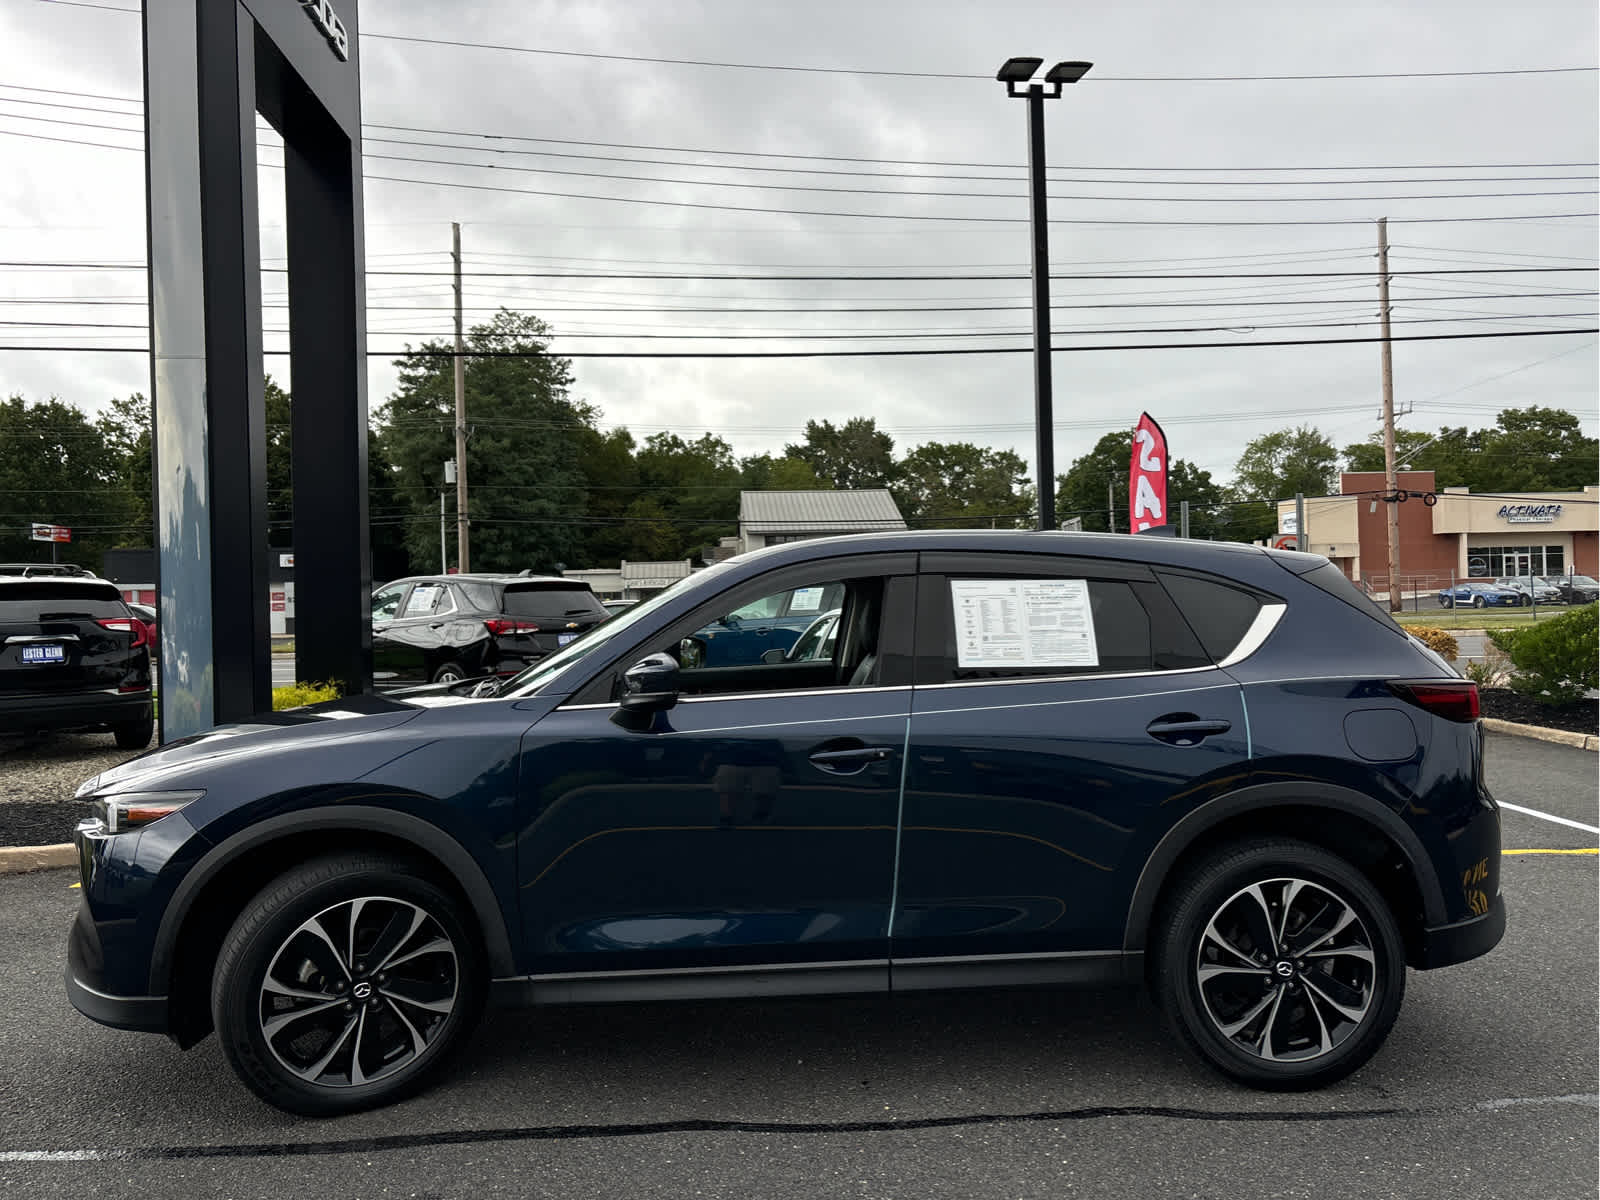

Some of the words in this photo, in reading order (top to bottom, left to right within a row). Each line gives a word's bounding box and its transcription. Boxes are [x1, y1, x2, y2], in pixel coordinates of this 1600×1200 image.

[1498, 504, 1562, 517] ACTIVATE
[23, 647, 44, 659] LESTER
[45, 647, 63, 658] GLENN
